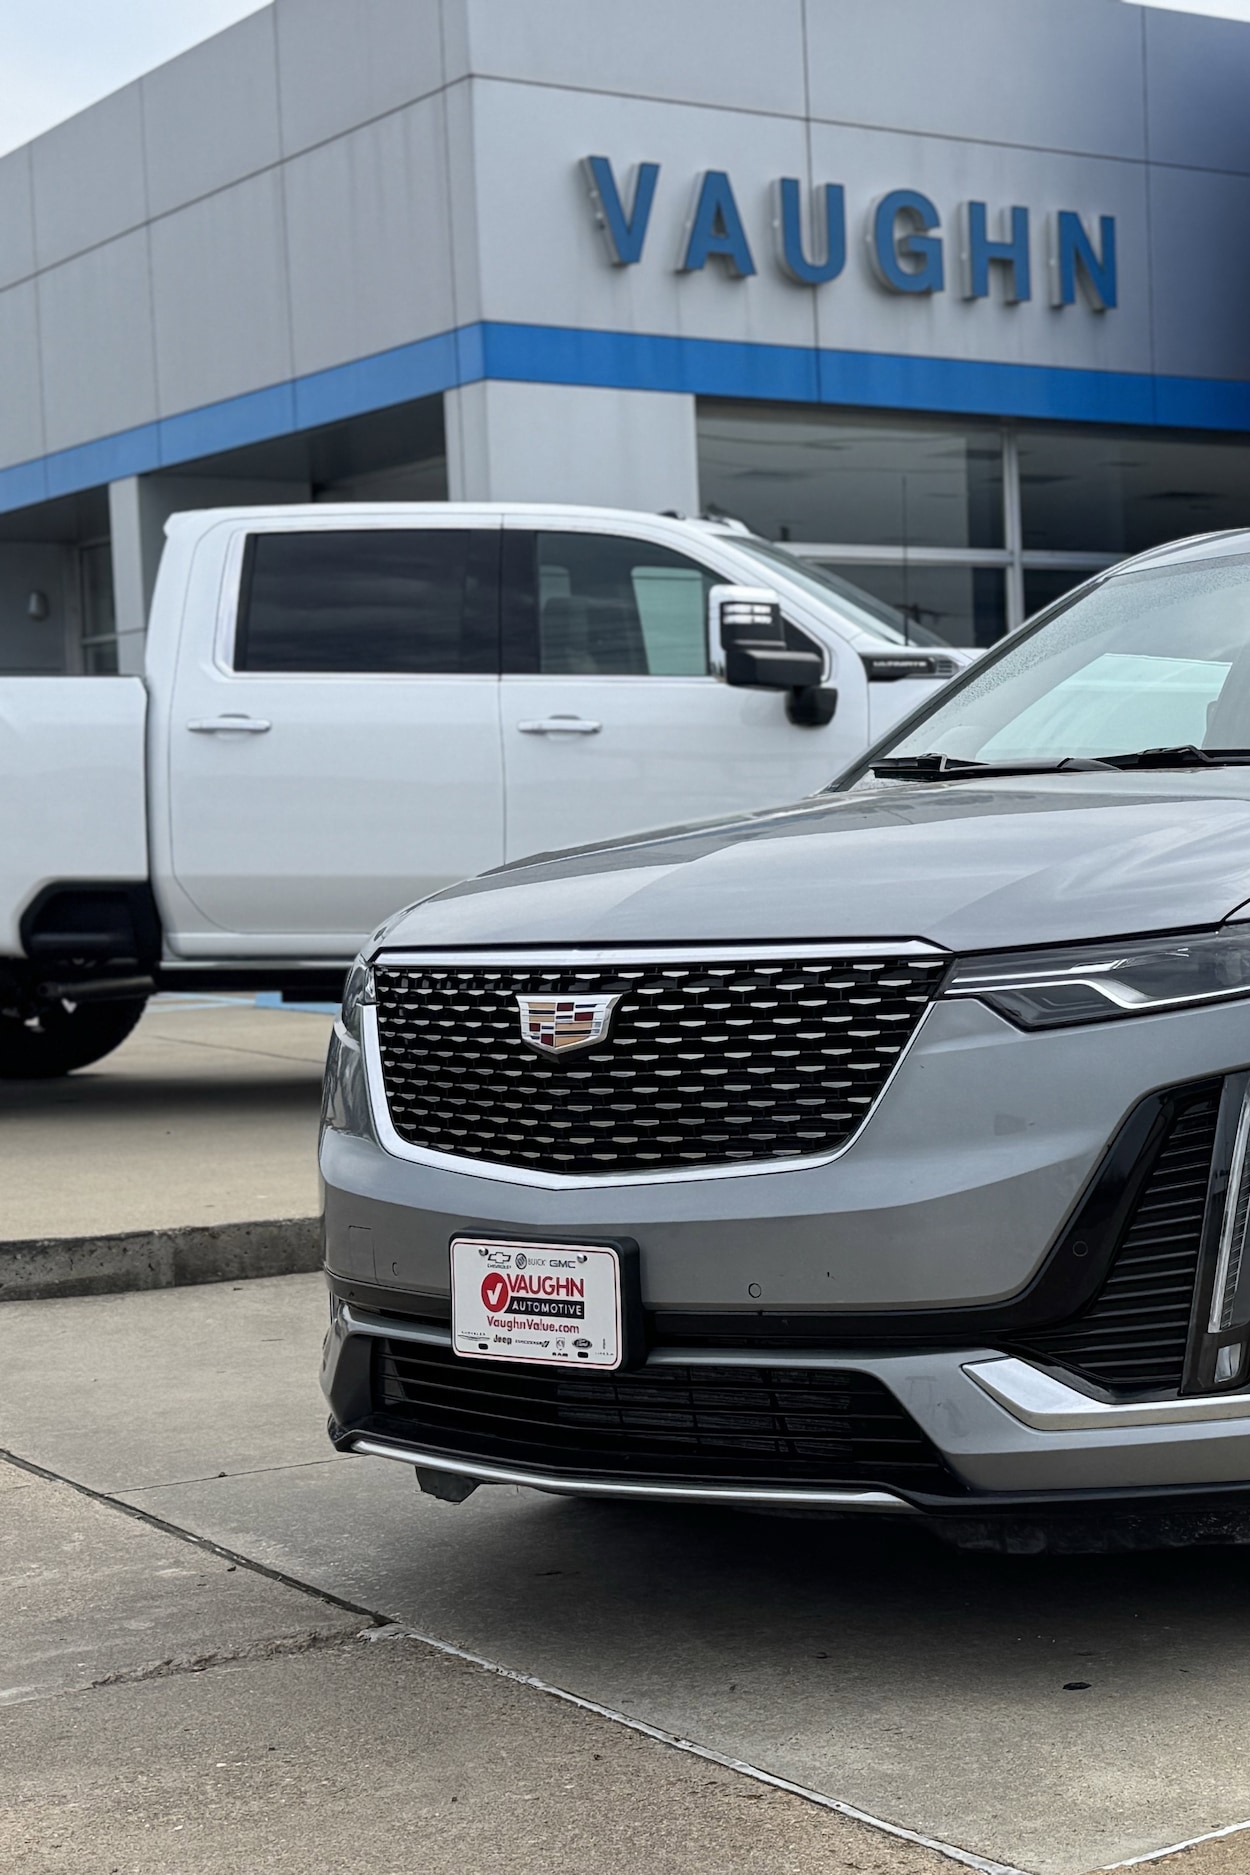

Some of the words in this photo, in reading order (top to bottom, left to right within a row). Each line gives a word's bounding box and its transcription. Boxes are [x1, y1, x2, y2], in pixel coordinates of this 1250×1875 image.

[583, 154, 1118, 311] VAUGHN
[527, 1257, 547, 1267] BUICK
[549, 1259, 576, 1269] GMC
[506, 1273, 584, 1298] VAUGHN
[511, 1300, 583, 1316] AUTOMOTIVE
[486, 1315, 580, 1334] VaughnValue.com
[493, 1334, 512, 1346] Jeep
